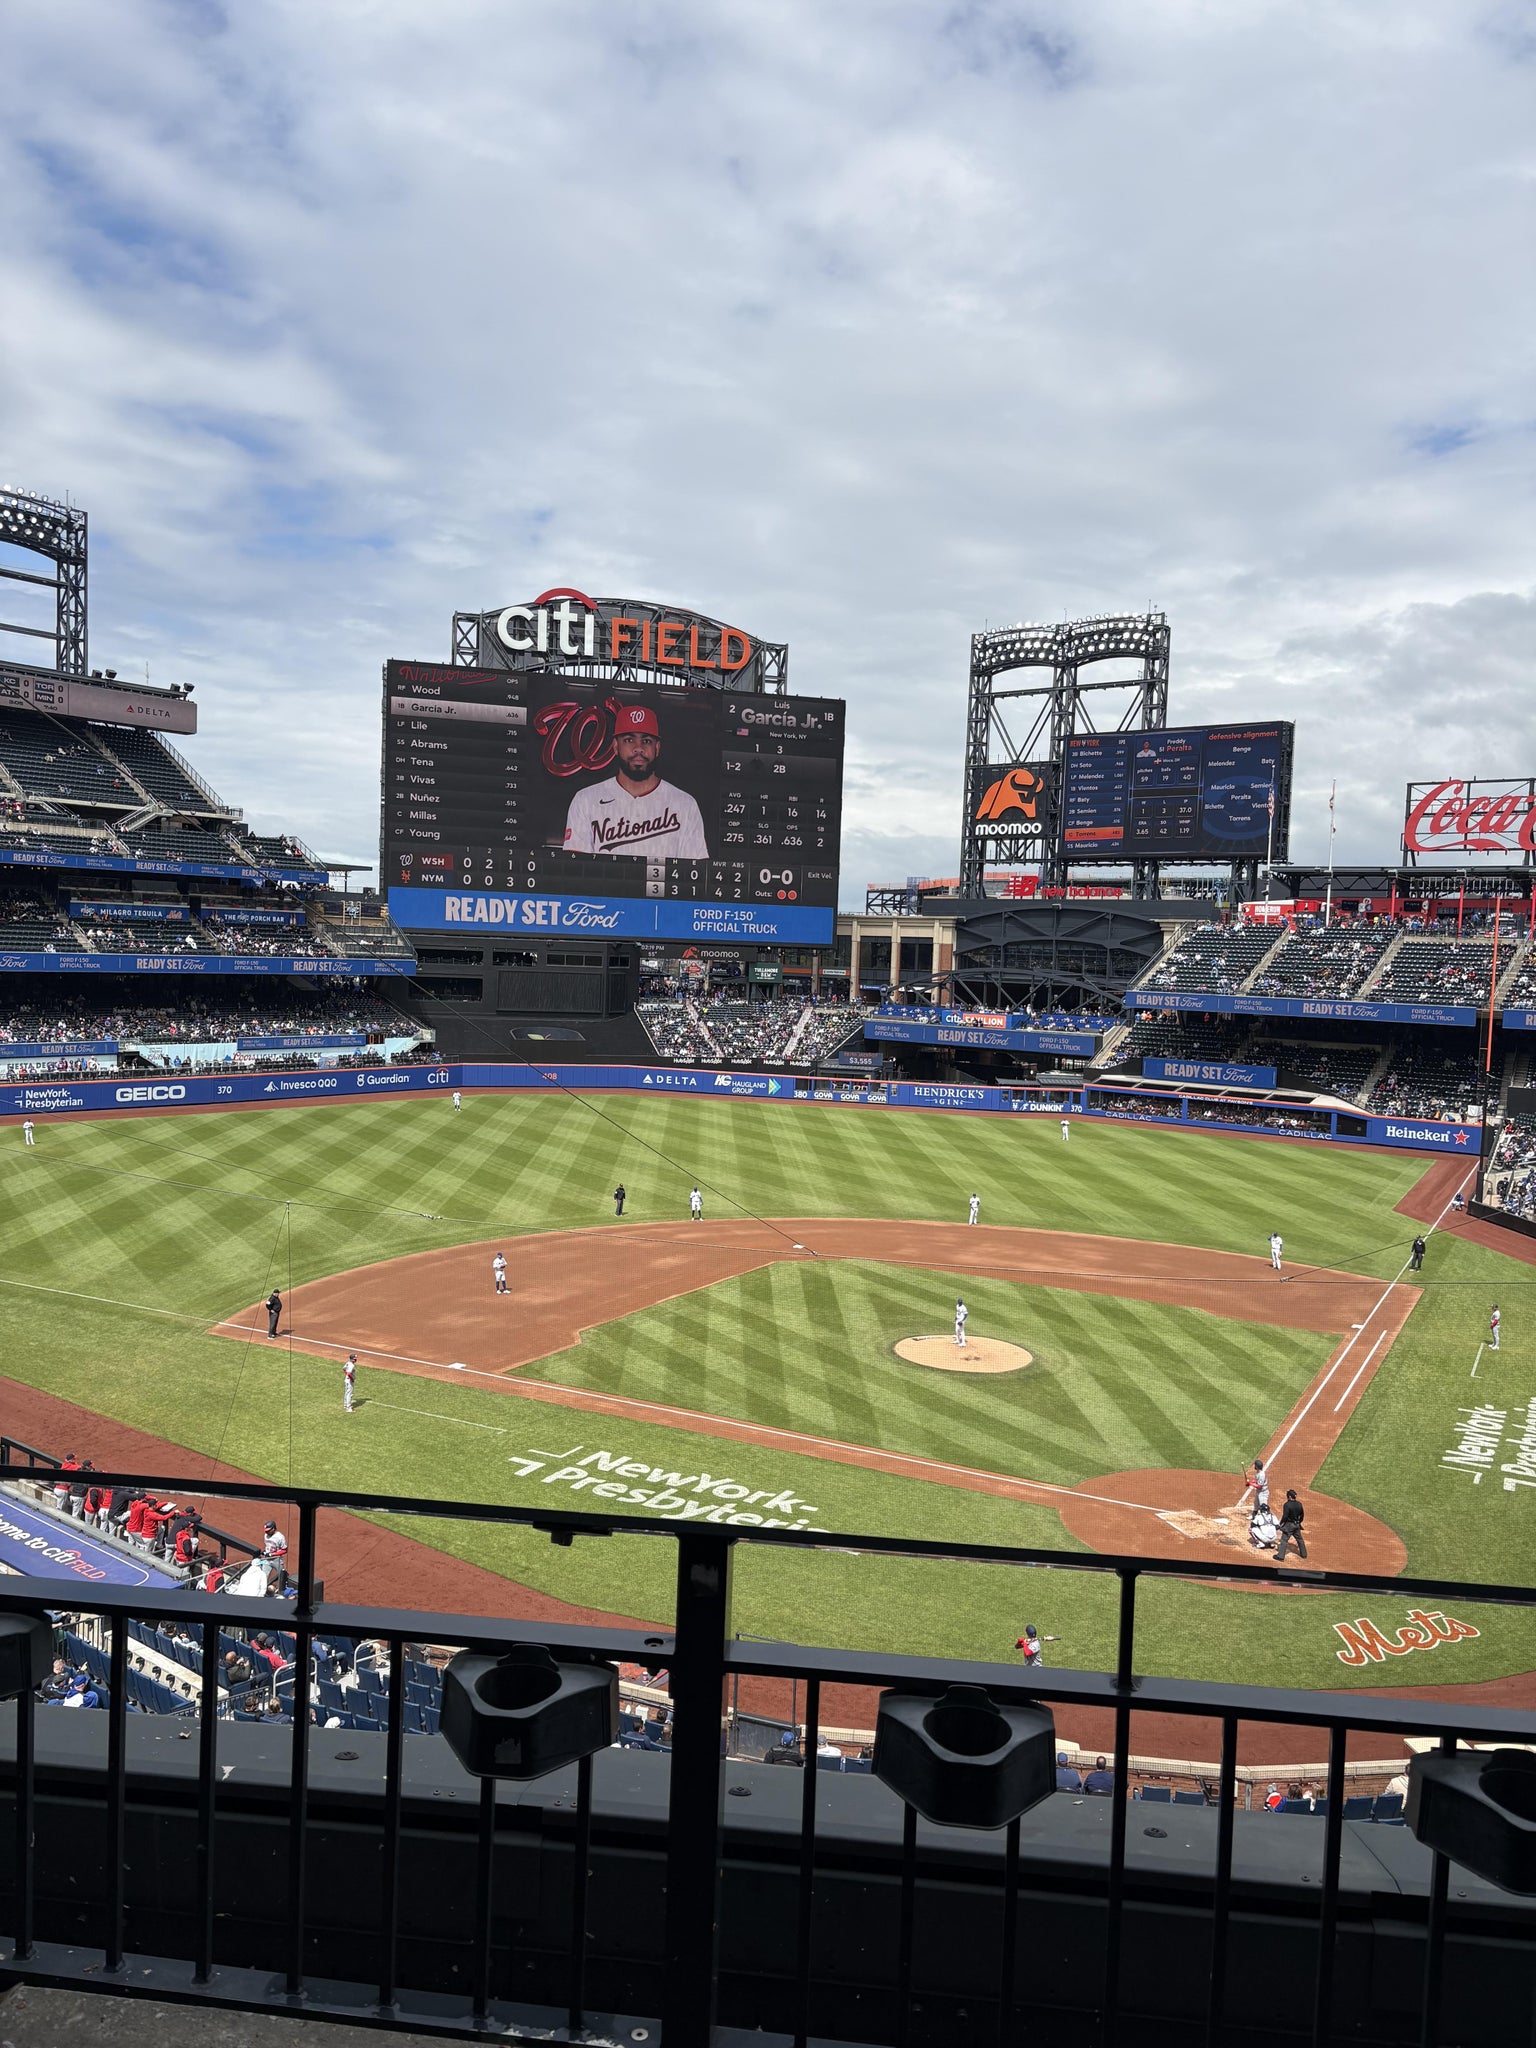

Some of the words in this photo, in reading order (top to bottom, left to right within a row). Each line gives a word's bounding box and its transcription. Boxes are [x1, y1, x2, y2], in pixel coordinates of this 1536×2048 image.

[497, 589, 597, 656] citi
[611, 617, 751, 670] FIELD
[412, 685, 440, 695] Wood
[138, 706, 171, 718] DELTA
[444, 705, 456, 714] Jr.
[729, 704, 736, 714] 2
[774, 701, 790, 710] Luis
[742, 708, 796, 727] García
[801, 714, 822, 729] Jr.
[824, 712, 834, 722] 1B
[411, 722, 428, 730] Lile
[1243, 731, 1278, 739] alignment
[410, 740, 448, 750] Abrams
[776, 746, 783, 754] 3
[410, 757, 434, 766] Tena
[726, 762, 741, 770] 1-2
[773, 765, 786, 774] 2B
[410, 775, 436, 784] Vivas
[410, 793, 440, 802] Nuñez
[410, 812, 437, 820] Millas
[724, 804, 746, 814] .247
[788, 808, 798, 817] 16
[816, 810, 826, 818] 14
[591, 807, 680, 846] Nationals
[976, 822, 1042, 835] moomoo
[410, 829, 440, 840] Young
[724, 833, 744, 842] .275
[754, 835, 772, 844] .361
[781, 836, 802, 846] .636
[817, 838, 824, 847] 2
[13, 853, 36, 862] READY
[36, 854, 48, 863] SET
[136, 862, 154, 871] READY
[156, 863, 167, 872] SET
[422, 857, 445, 866] WSH
[463, 858, 472, 868] 0
[486, 859, 494, 870] 2
[527, 861, 536, 872] 0
[652, 868, 660, 878] 3
[672, 869, 679, 880] 4
[690, 870, 698, 880] 0
[242, 869, 259, 878] READY
[716, 872, 722, 882] 4
[734, 872, 742, 882] 2
[760, 868, 793, 884] 0-0
[422, 874, 444, 882] NYM
[463, 874, 472, 885] 0
[484, 875, 493, 886] 0
[506, 876, 514, 887] 3
[527, 878, 536, 888] 0
[652, 885, 660, 894] 3
[672, 886, 678, 896] 3
[1040, 886, 1066, 896] new
[1068, 885, 1123, 897] balance
[715, 888, 722, 897] 4
[734, 888, 741, 898] 2
[445, 896, 518, 924] READY
[522, 900, 562, 926] SET
[562, 902, 621, 928] Ford
[693, 908, 722, 920] FORD
[693, 921, 740, 932] OFFICIAL
[742, 923, 778, 934] TRUCK
[136, 958, 166, 969] READY
[167, 960, 182, 970] SET
[182, 959, 206, 970] Ford
[294, 961, 318, 971] READY
[319, 962, 332, 972] SET
[332, 962, 352, 972] Ford
[1136, 994, 1164, 1005] READY
[1164, 996, 1180, 1006] SET
[1180, 996, 1204, 1008] Ford
[1303, 1002, 1333, 1014] READY
[1335, 1005, 1354, 1016] SET
[1353, 1006, 1380, 1018] Ford
[300, 1038, 310, 1046] SET
[938, 1029, 966, 1042] READY
[968, 1031, 985, 1044] SET
[984, 1033, 1009, 1046] Ford
[42, 1045, 62, 1054] READY
[64, 1045, 78, 1053] SET
[428, 1068, 448, 1083] citi
[1164, 1062, 1200, 1078] READY
[1202, 1066, 1223, 1080] SET
[1223, 1068, 1254, 1084] Ford
[280, 1080, 316, 1090] Invesco
[318, 1078, 337, 1088] QQQ
[367, 1074, 410, 1085] Guardian
[656, 1075, 697, 1086] DELTA
[732, 1081, 766, 1089] HAUGLAND
[25, 1088, 70, 1099] NewYork-
[116, 1085, 186, 1102] GEICO
[218, 1086, 232, 1094] 370
[794, 1090, 808, 1098] 380
[814, 1091, 833, 1100] GOYA
[914, 1087, 984, 1099] HENDRICK'S
[25, 1098, 83, 1109] Presbyterian
[840, 1093, 860, 1102] GOYA
[867, 1094, 886, 1102] GOYA
[1030, 1104, 1064, 1112] DUNKIN'
[1105, 1110, 1152, 1122] CADILLAC
[1278, 1128, 1332, 1140] CADILLAC
[1386, 1126, 1450, 1142] Heineken
[576, 1450, 819, 1513] NewYork-
[24, 1537, 48, 1548] to
[65, 1560, 106, 1579] FIELD
[1332, 1610, 1481, 1666] Mets
